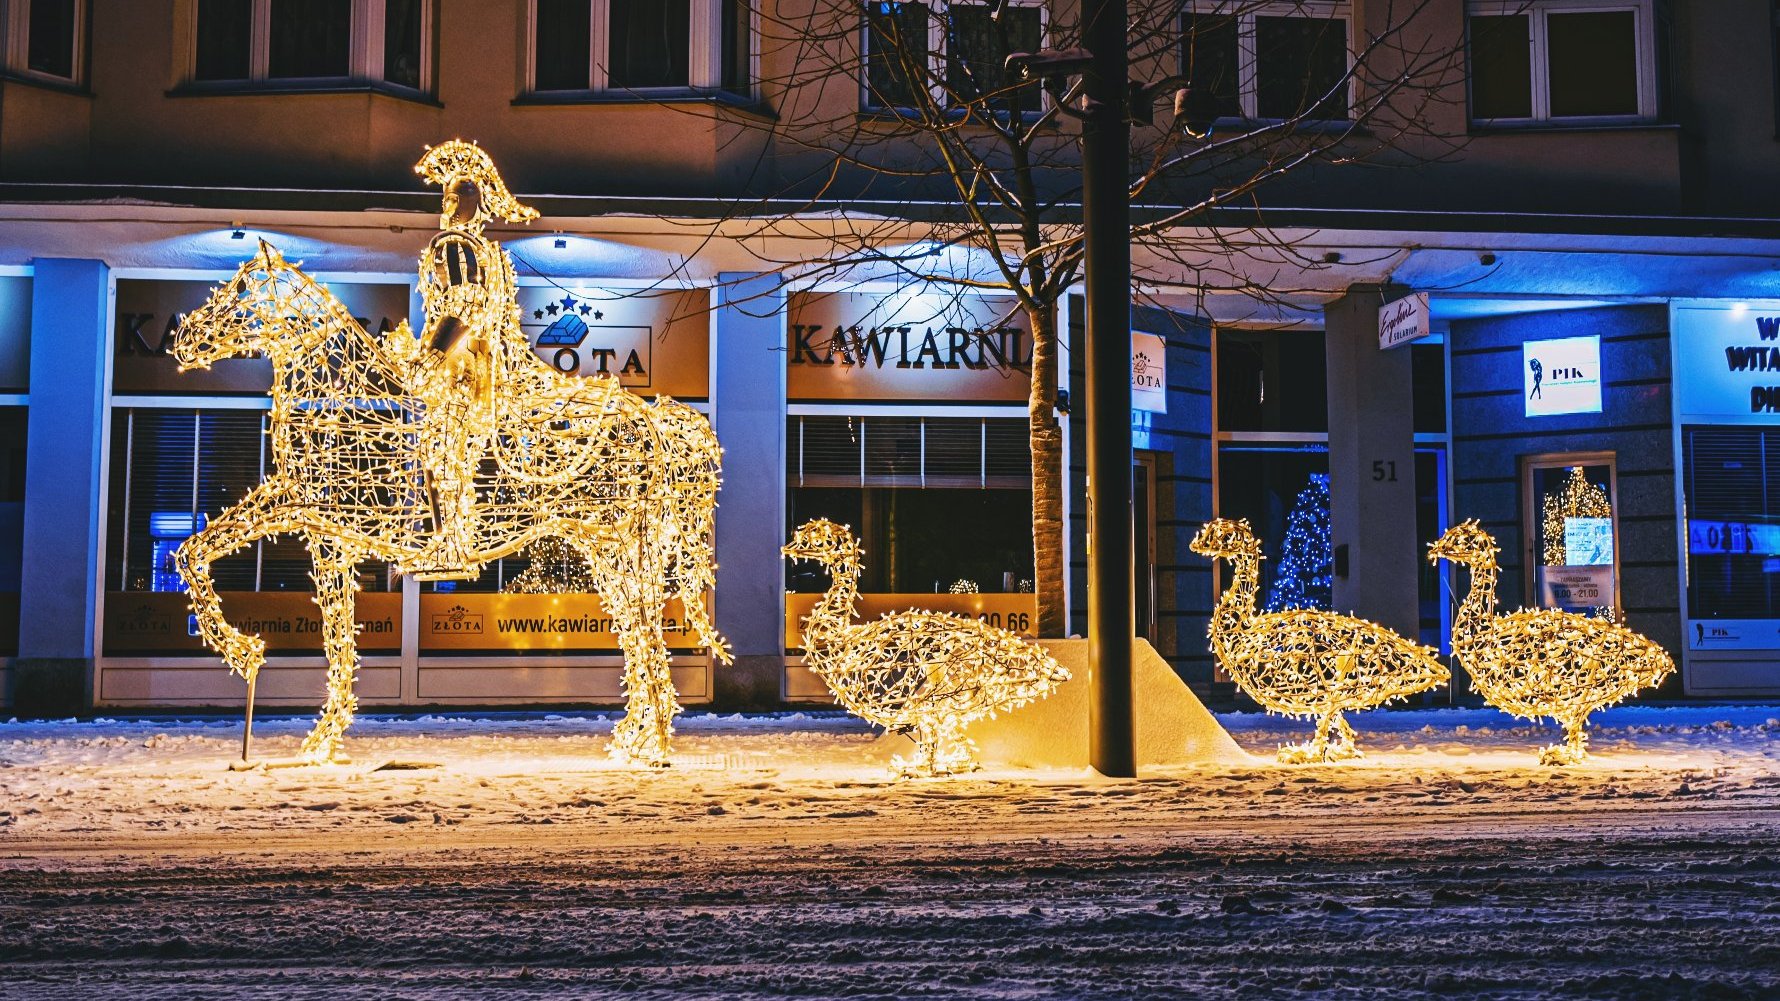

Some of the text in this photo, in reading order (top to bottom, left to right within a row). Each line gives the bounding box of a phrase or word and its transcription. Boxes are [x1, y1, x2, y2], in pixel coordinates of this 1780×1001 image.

[1393, 325, 1418, 340] SOLARIUM
[1552, 367, 1584, 380] PIK
[1373, 460, 1397, 482] 51
[1579, 589, 1599, 598] 21.00
[227, 616, 291, 633] wiarnia
[295, 616, 325, 633] Złot
[434, 621, 481, 630] ZŁOTA
[1007, 612, 1029, 632] 66
